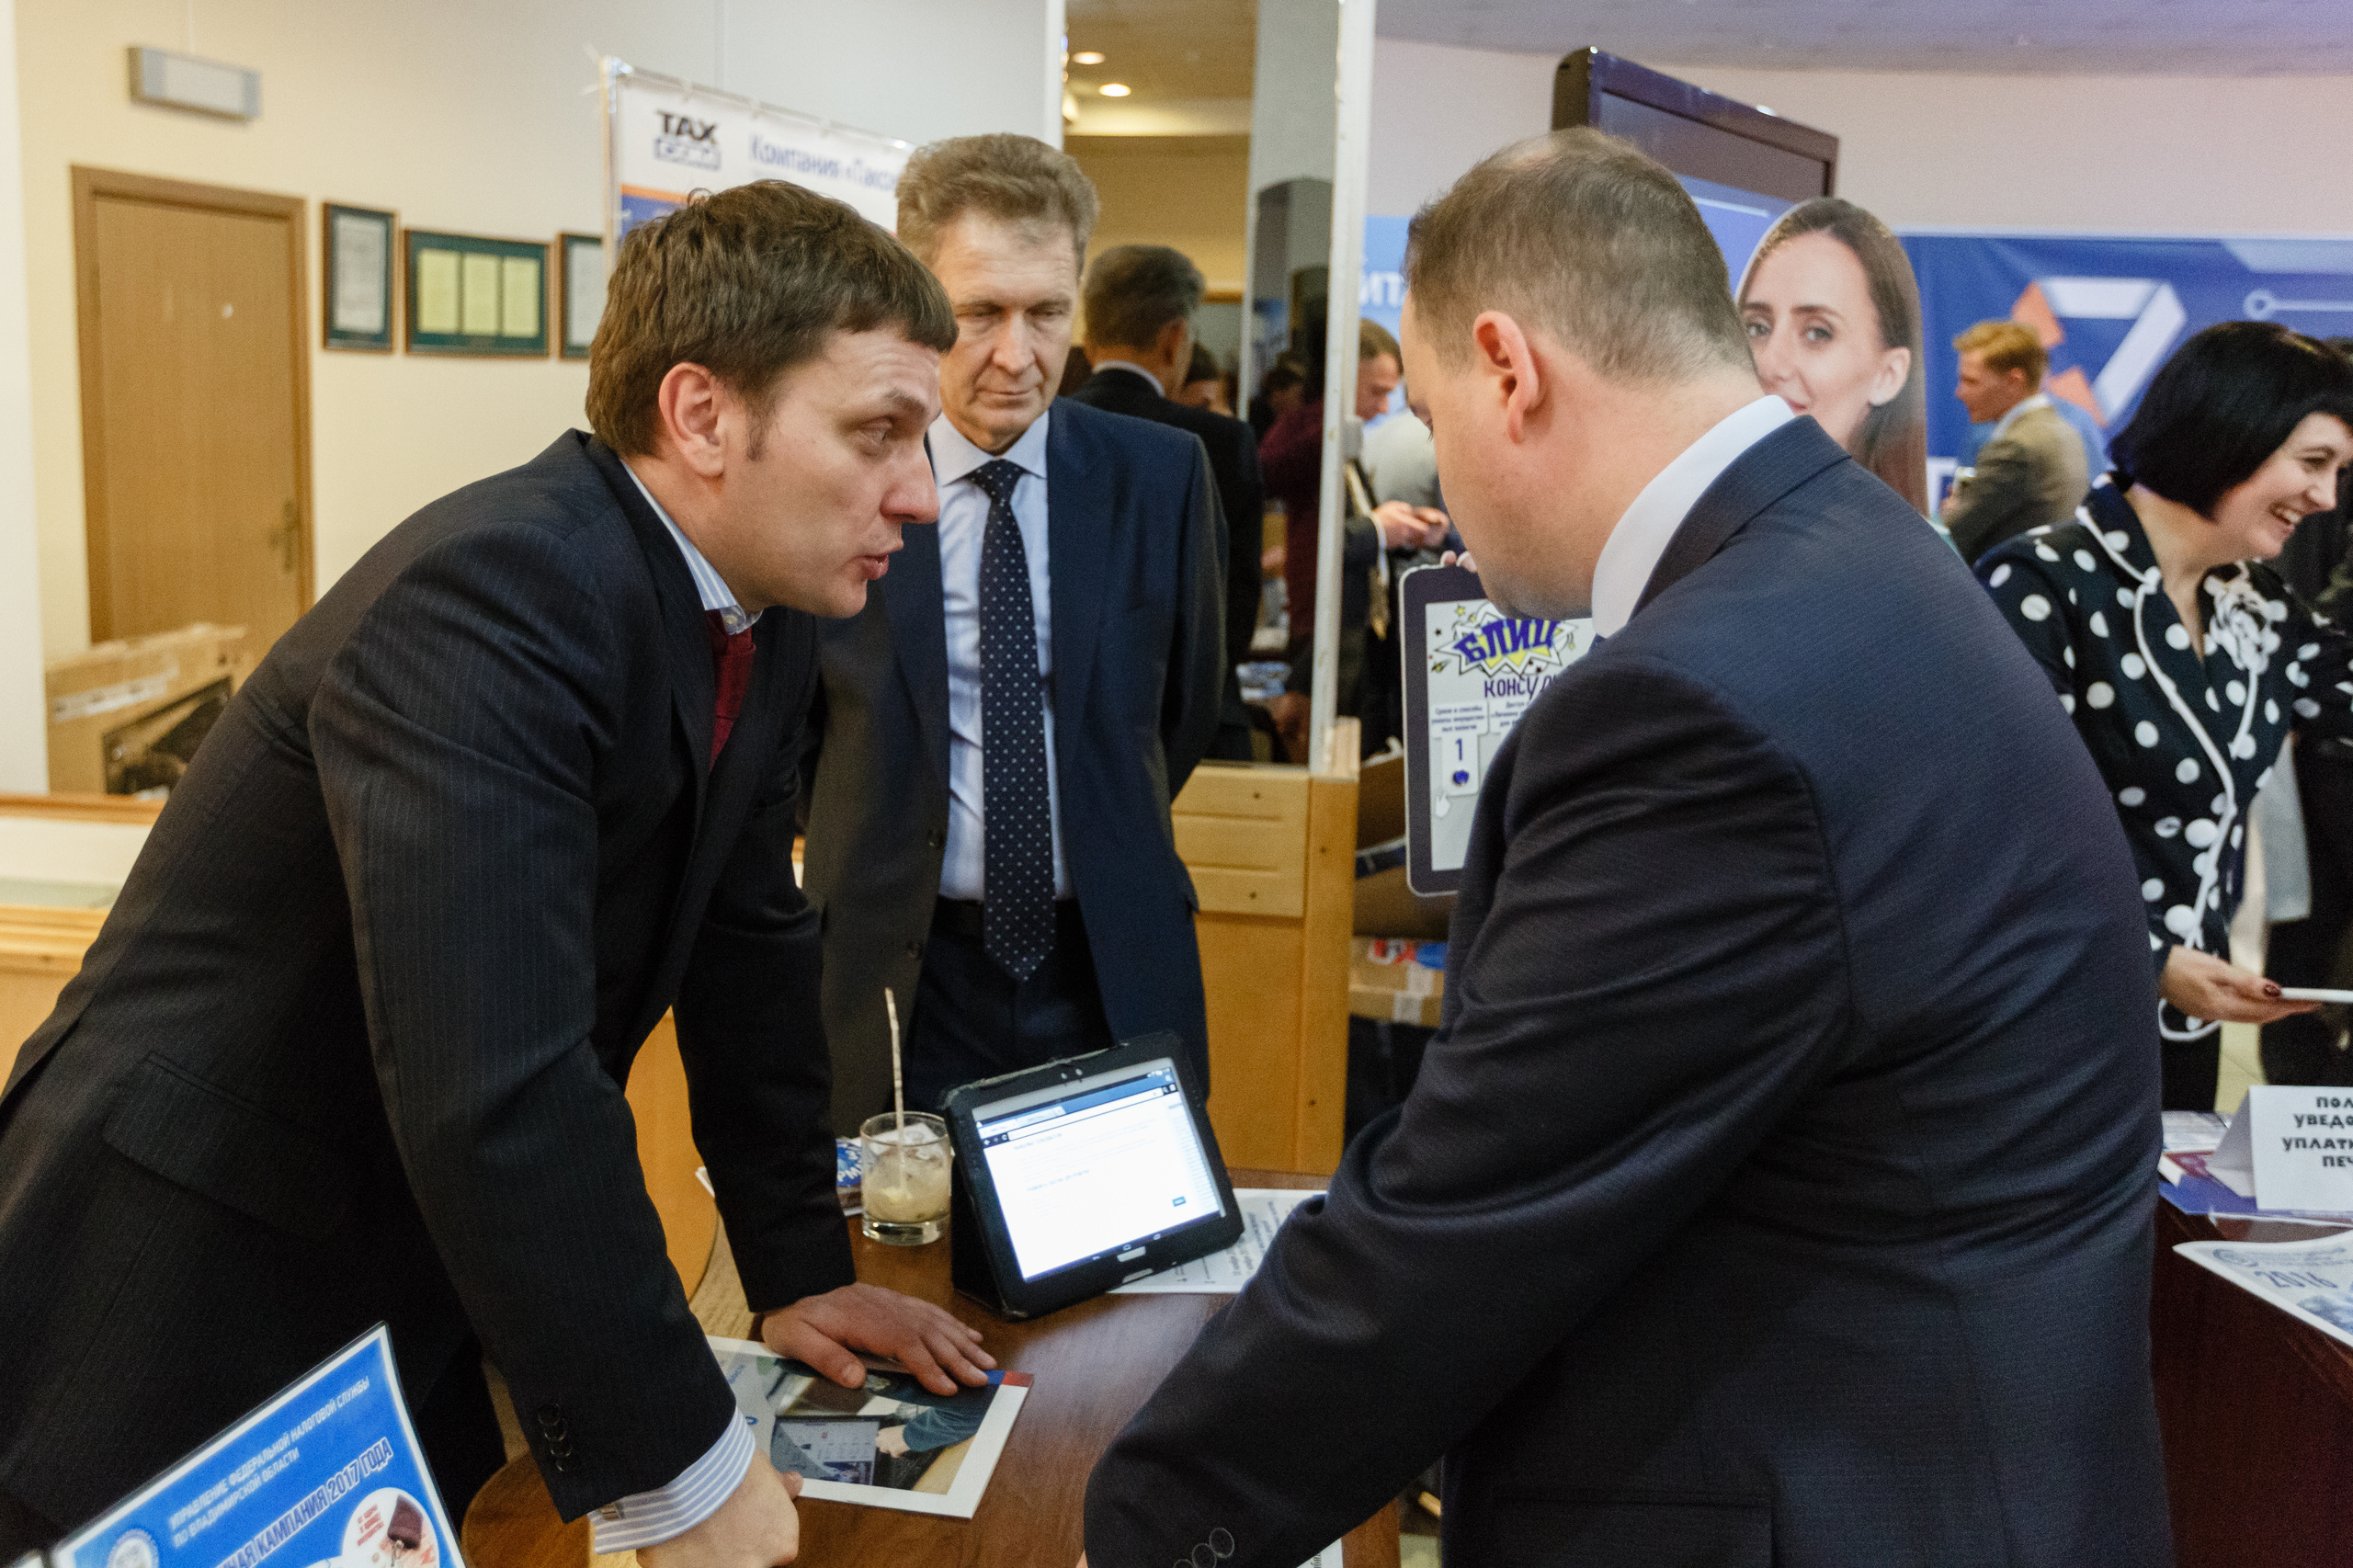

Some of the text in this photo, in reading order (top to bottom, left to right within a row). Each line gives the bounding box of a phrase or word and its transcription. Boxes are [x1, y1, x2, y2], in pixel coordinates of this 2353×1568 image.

[656, 108, 719, 145] TAX
[750, 134, 840, 180] Компания
[1452, 618, 1562, 664] БЛИЦ
[1454, 738, 1463, 761] 1
[2315, 1096, 2353, 1108] ПОЛ
[2254, 1270, 2338, 1289] 2016
[168, 1375, 370, 1531] УПРАВЛЕНИЕ ФЕДЕРАЛЬНОЙ НАЛОГОВОЙ СЛУЖБЫ
[172, 1447, 301, 1549] ПО ВЛАДИМИРСКОЙ ОБЛАСТИ
[255, 1485, 331, 1560] КАМПАНИЯ
[326, 1458, 361, 1504] 2017
[358, 1436, 394, 1478] ГОДА
